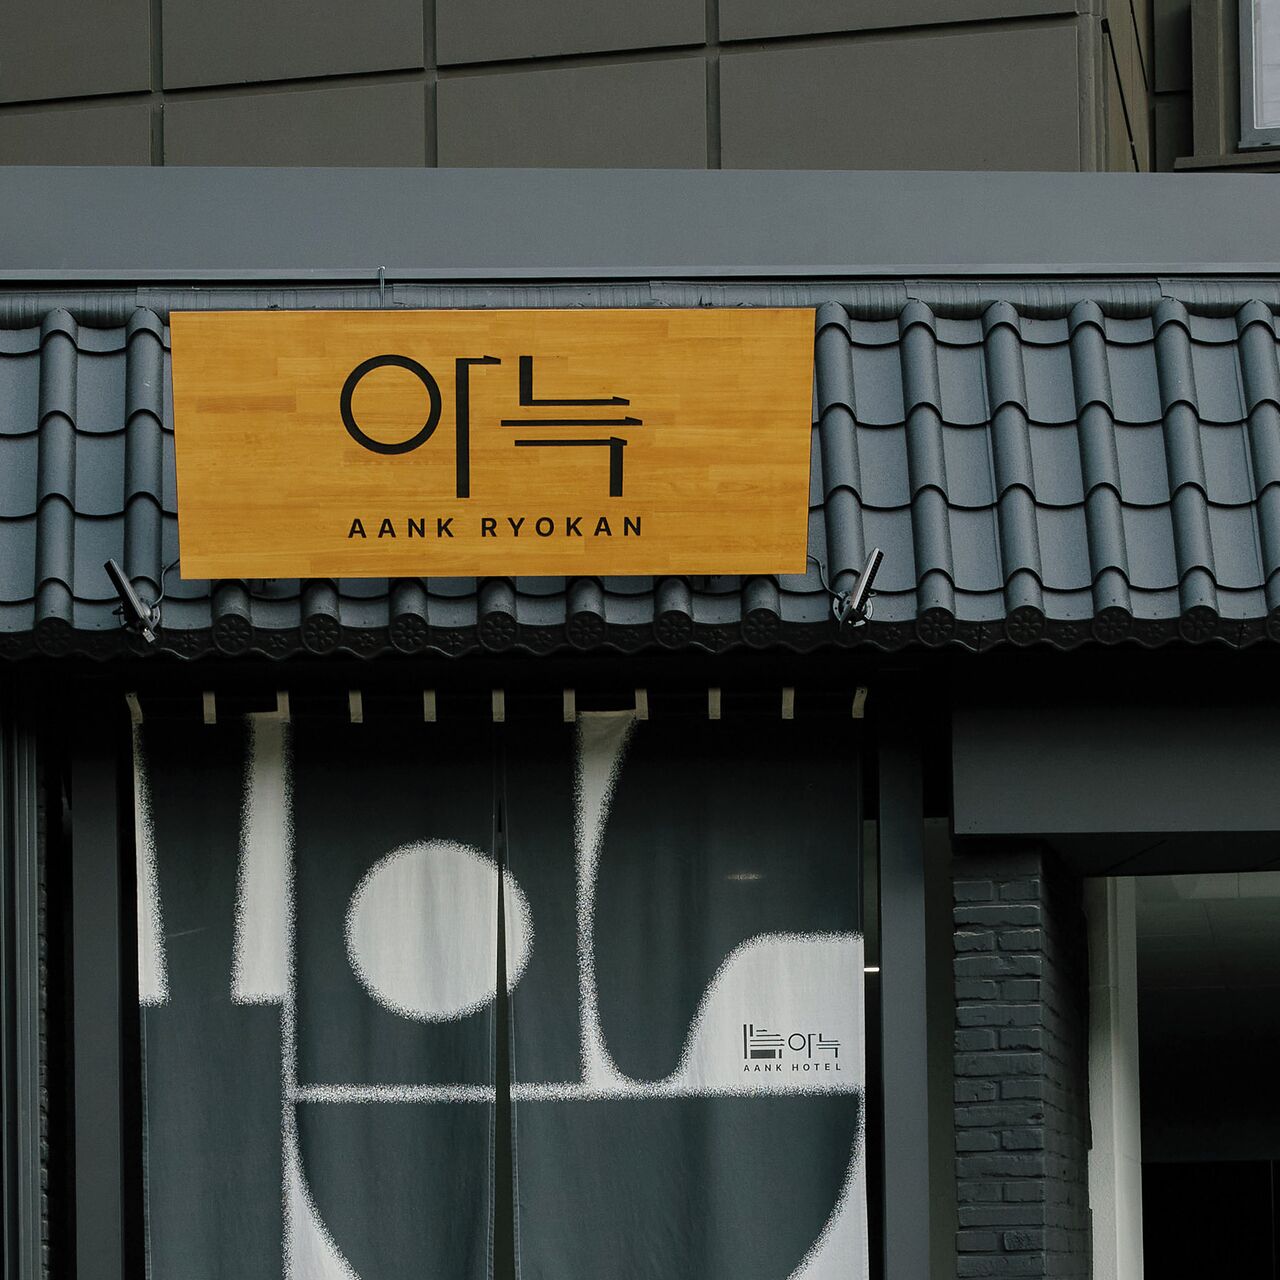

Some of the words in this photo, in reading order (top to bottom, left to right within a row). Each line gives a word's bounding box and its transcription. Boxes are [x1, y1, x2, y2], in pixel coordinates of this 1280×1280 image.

[339, 353, 643, 499] 아늑
[347, 517, 455, 539] AANK
[481, 516, 642, 538] RYOKAN
[743, 1063, 782, 1072] AANK
[791, 1063, 841, 1072] HOTEL
